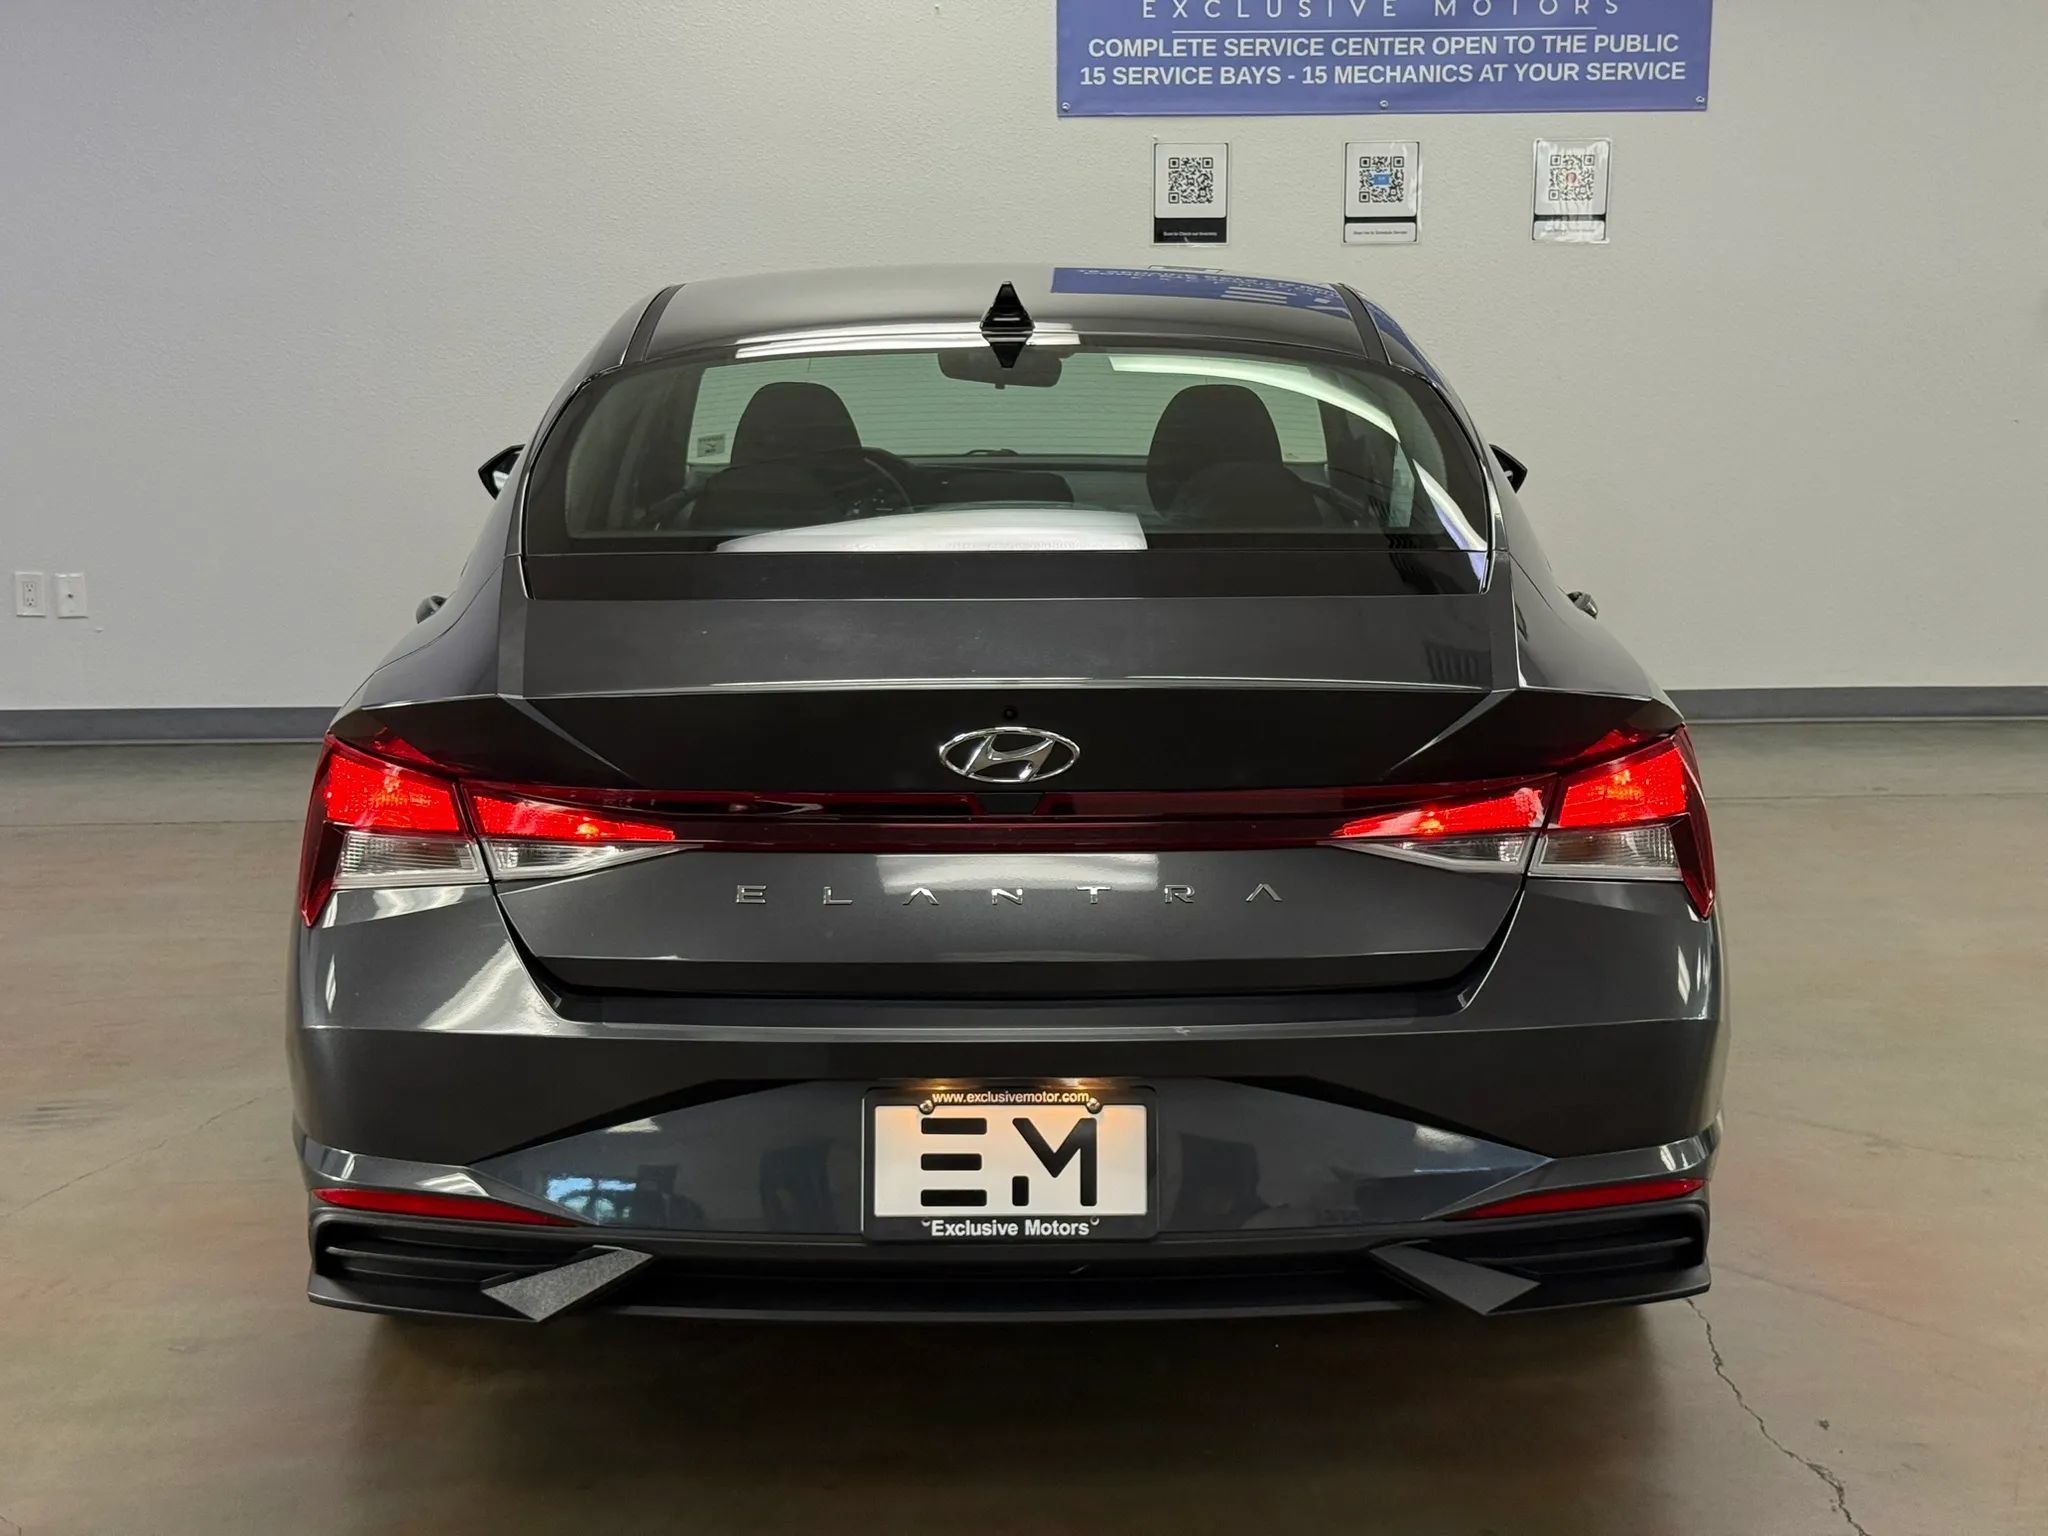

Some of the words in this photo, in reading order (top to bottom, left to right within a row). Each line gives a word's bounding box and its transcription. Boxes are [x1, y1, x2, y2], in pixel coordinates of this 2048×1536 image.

[1142, 0, 1397, 18] EXCLUSIVE
[1088, 38, 1218, 58] COMPLETE
[1223, 37, 1324, 57] SERVICE
[1331, 36, 1425, 56] CENTER
[1432, 35, 1497, 55] OPEN
[1504, 35, 1535, 54] TO
[1542, 35, 1588, 54] THE
[1594, 34, 1679, 53] PUBLIC
[1080, 66, 1106, 86] 15
[1112, 66, 1213, 86] SERVICE
[1220, 65, 1282, 85] BAYS
[1302, 65, 1327, 84] 15
[1334, 63, 1473, 84] MECHANICS
[1478, 63, 1508, 83] AT
[1514, 62, 1580, 82] YOUR
[1585, 61, 1686, 81] SERVICE
[736, 884, 1283, 906] ELANTRA
[931, 1090, 1090, 1104] www.exclusivemotor.com
[931, 1219, 1019, 1237] Exclusive
[1024, 1219, 1090, 1237] Motors
